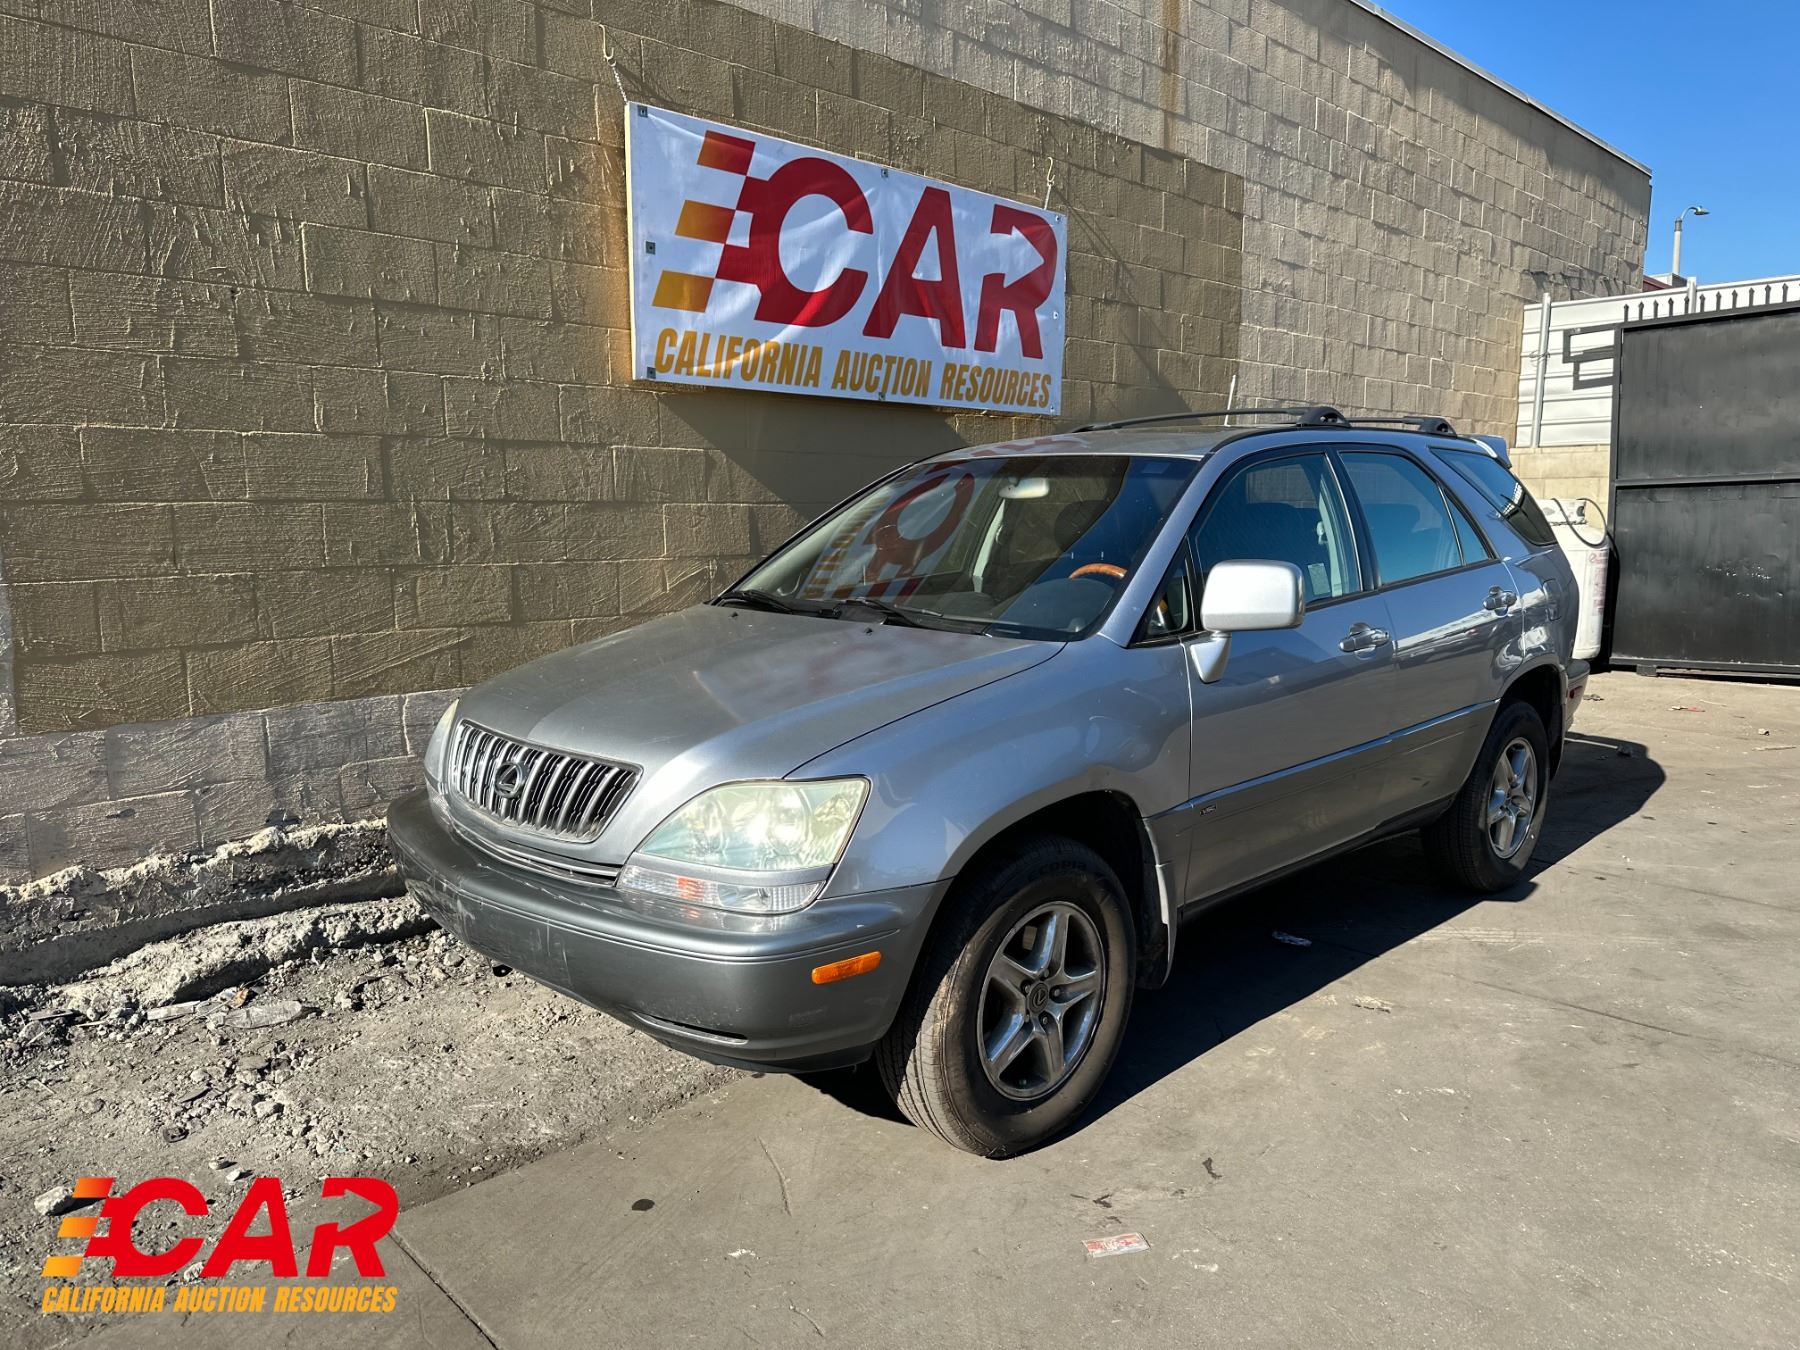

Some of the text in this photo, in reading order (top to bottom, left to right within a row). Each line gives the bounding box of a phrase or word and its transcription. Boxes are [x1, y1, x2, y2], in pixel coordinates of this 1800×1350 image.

[716, 157, 1057, 359] CAR
[654, 327, 1052, 408] CALIFORNIA AUCTION RESOURCES
